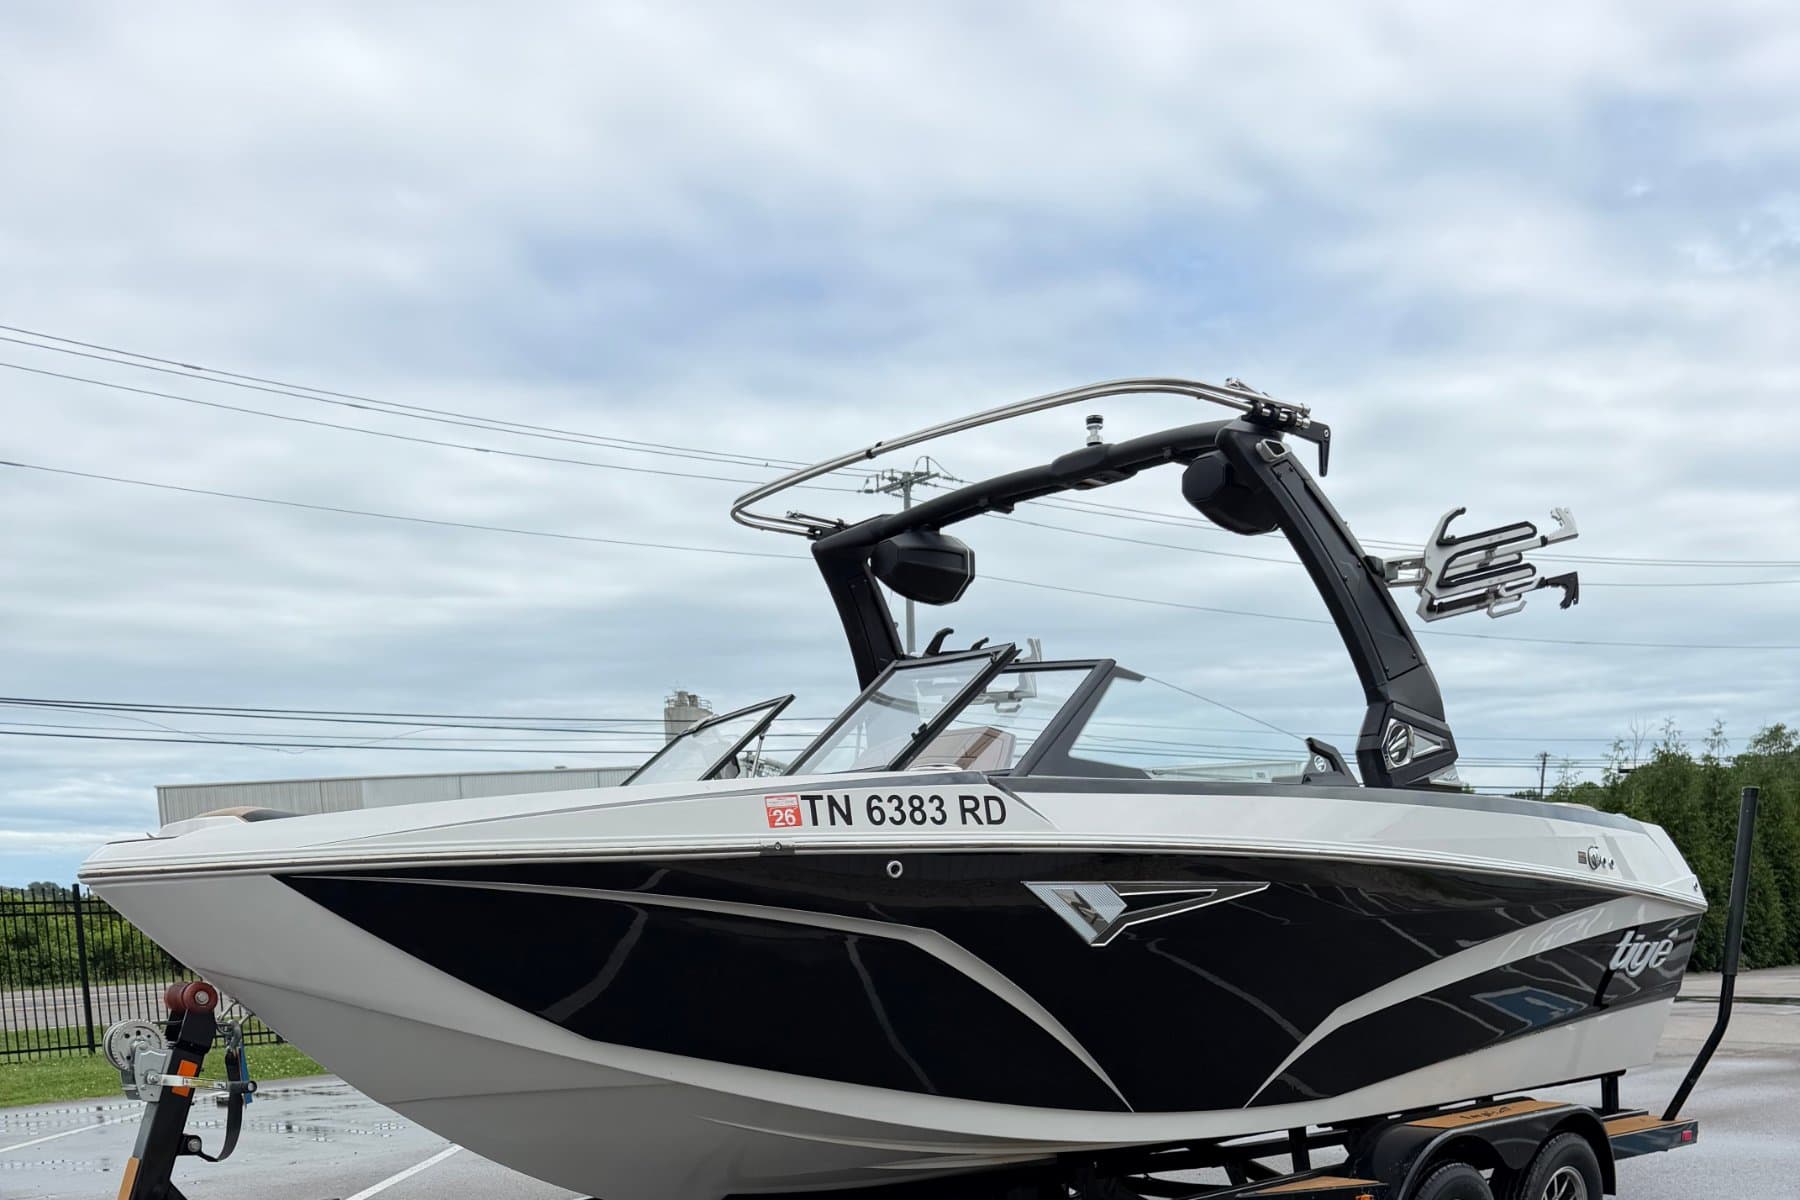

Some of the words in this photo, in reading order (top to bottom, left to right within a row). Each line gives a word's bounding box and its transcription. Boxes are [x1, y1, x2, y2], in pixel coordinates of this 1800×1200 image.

[772, 808, 797, 826] 26
[799, 794, 853, 826] TN
[866, 794, 947, 826] 6383
[958, 795, 1007, 825] RD
